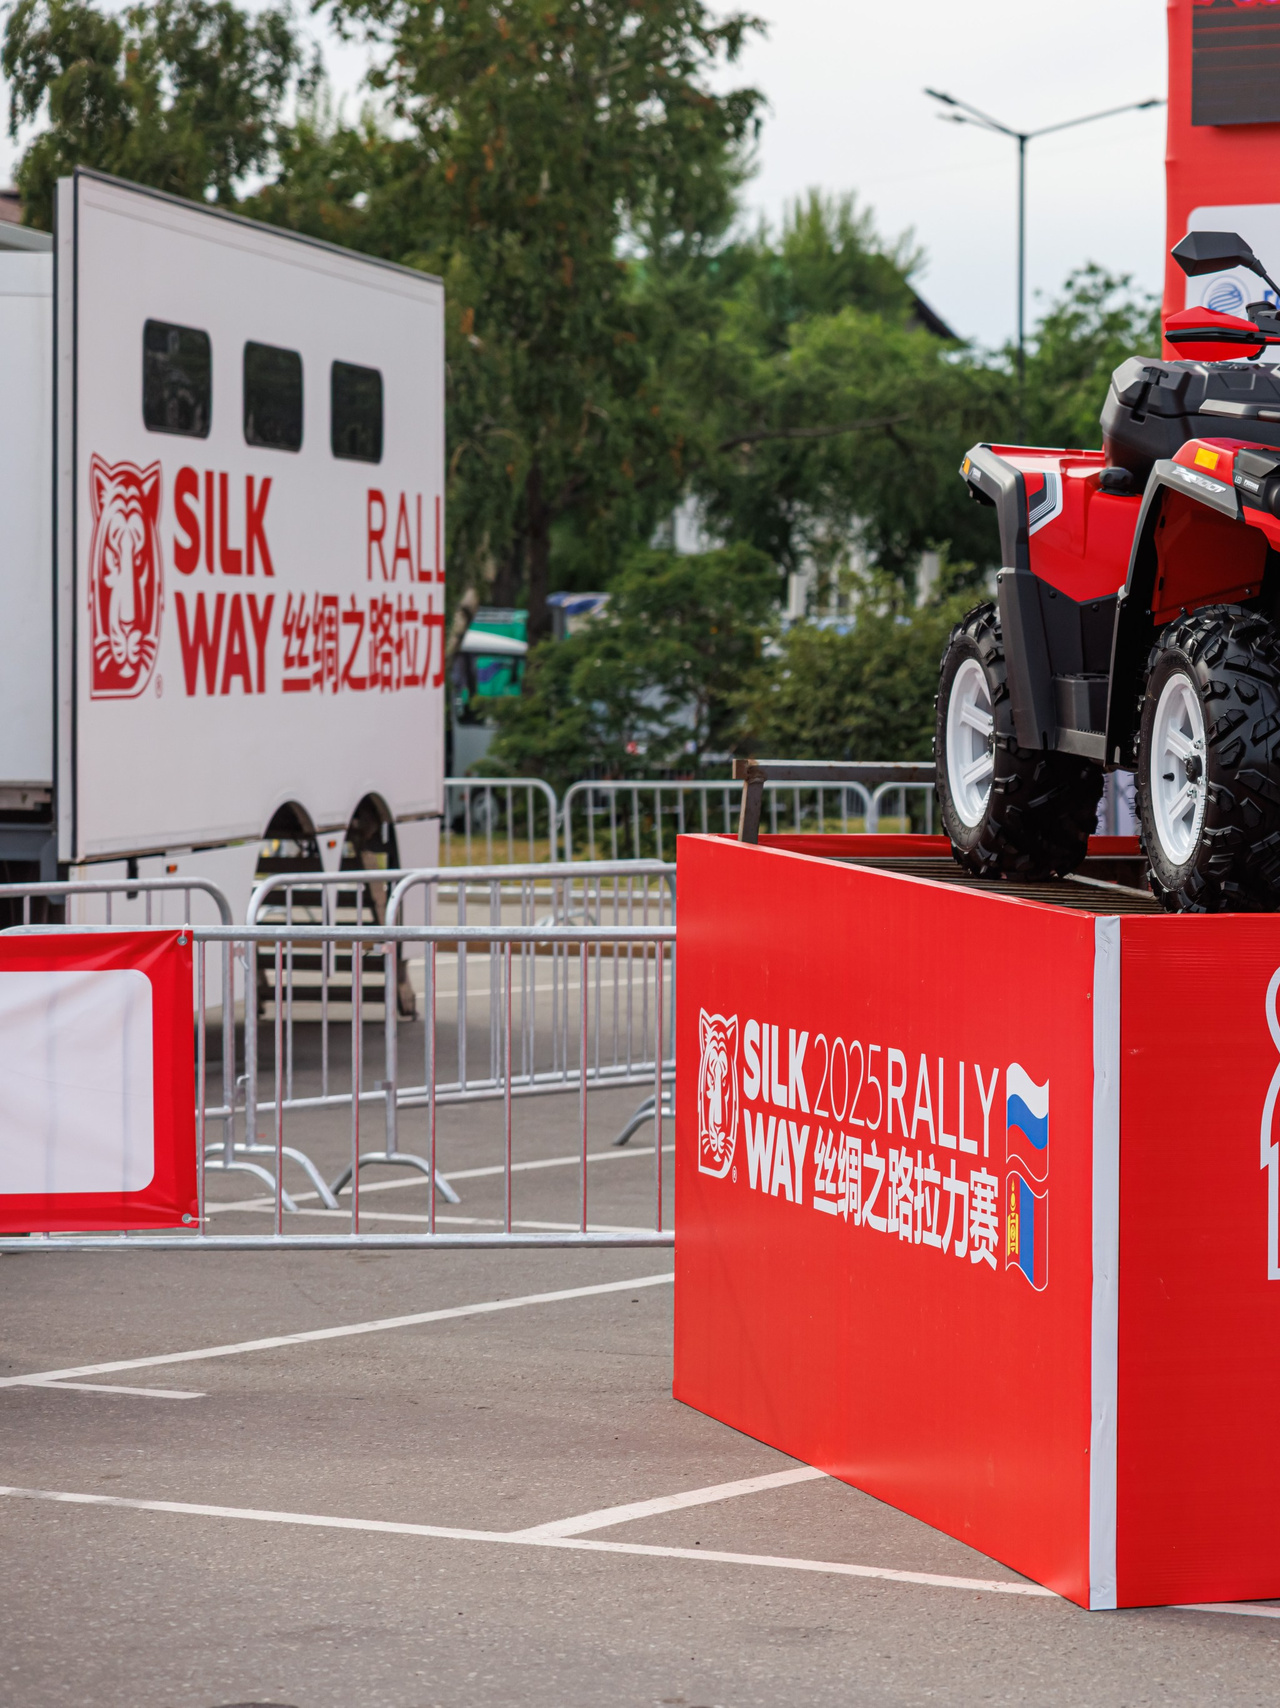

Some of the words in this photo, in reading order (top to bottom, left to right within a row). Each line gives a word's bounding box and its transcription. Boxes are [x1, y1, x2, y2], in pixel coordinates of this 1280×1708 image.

[173, 466, 276, 578] SILK
[173, 590, 276, 697] WAY
[281, 590, 446, 696] 丝绸之路拉力
[742, 1018, 810, 1114] SILK
[813, 1032, 884, 1132] 2025
[887, 1046, 1000, 1158] RALLY
[742, 1108, 810, 1206] WAY
[812, 1124, 1000, 1272] 丝绸之路拉力赛
